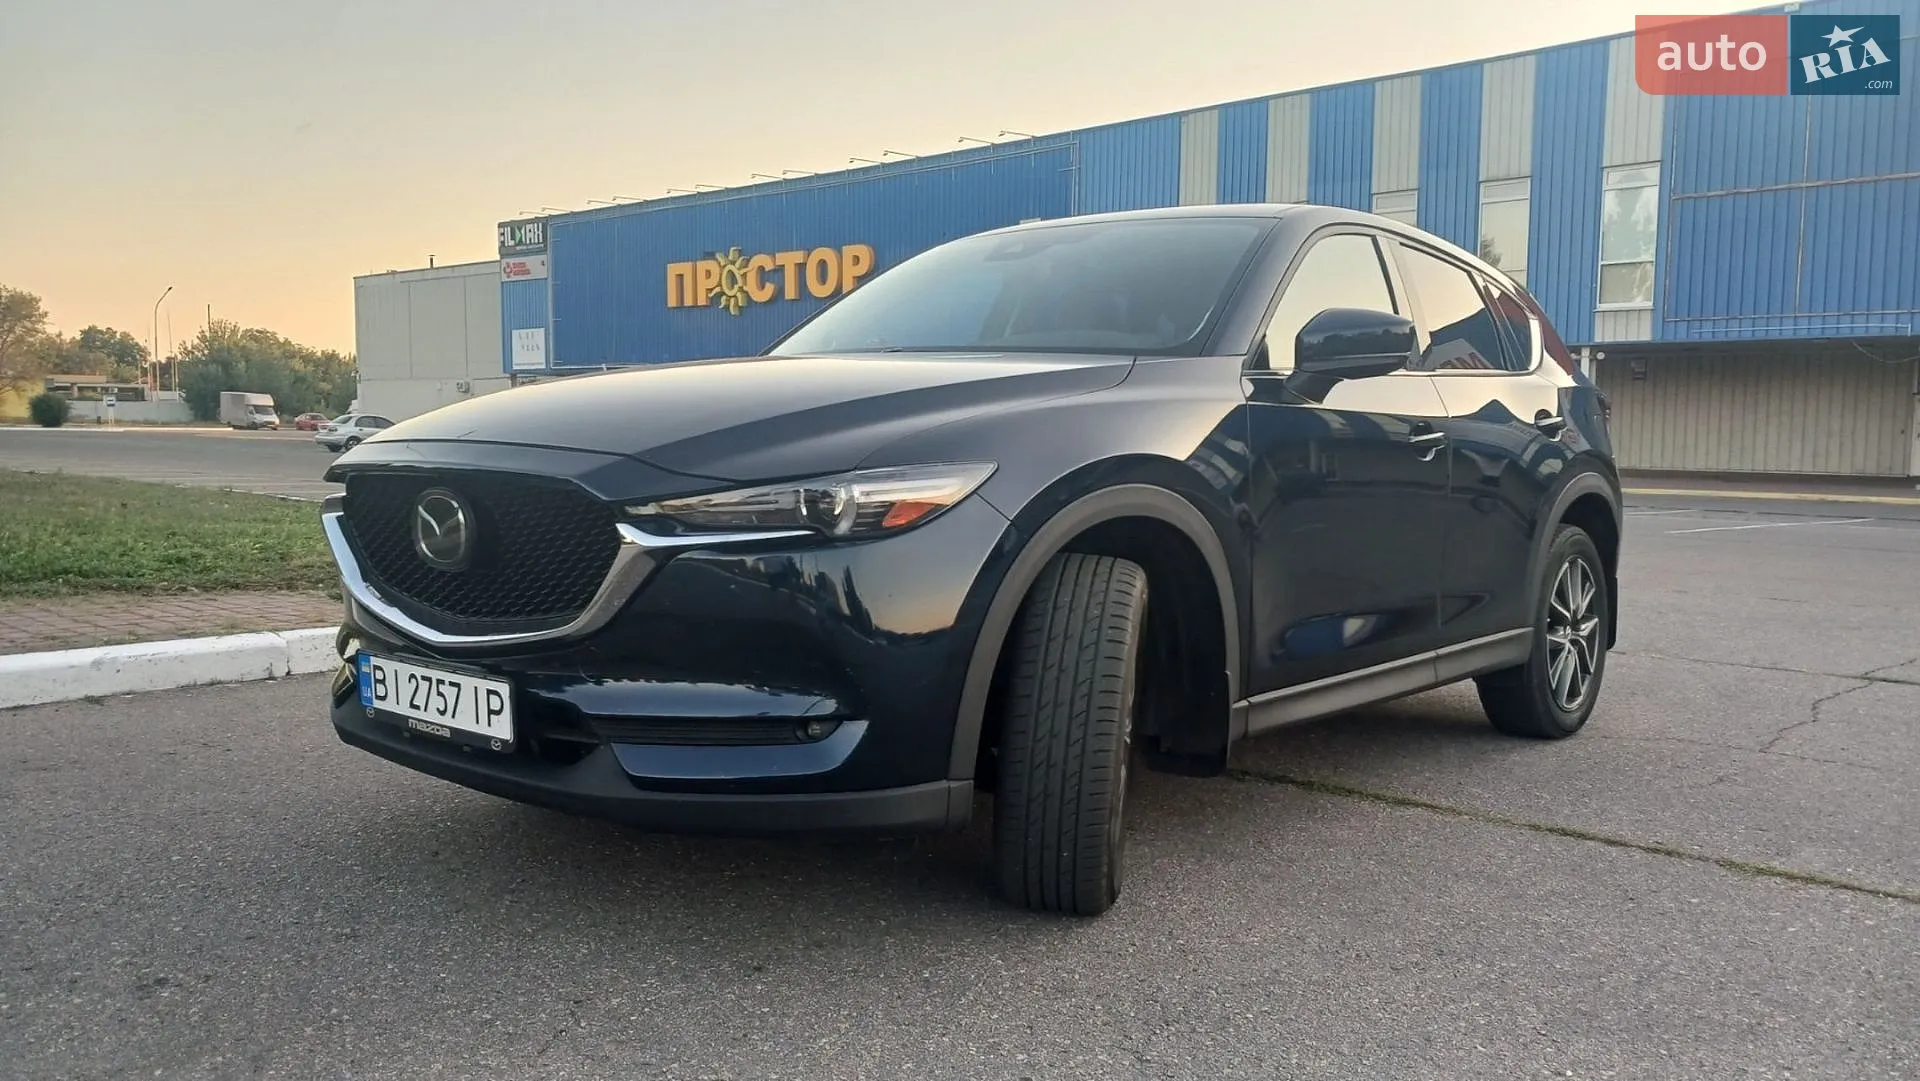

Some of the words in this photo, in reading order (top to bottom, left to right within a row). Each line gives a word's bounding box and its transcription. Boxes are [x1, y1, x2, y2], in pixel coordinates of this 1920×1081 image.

[667, 244, 875, 311] ПРОСТОР
[373, 664, 400, 706] BI
[408, 672, 462, 719] 2757
[474, 685, 505, 728] IP
